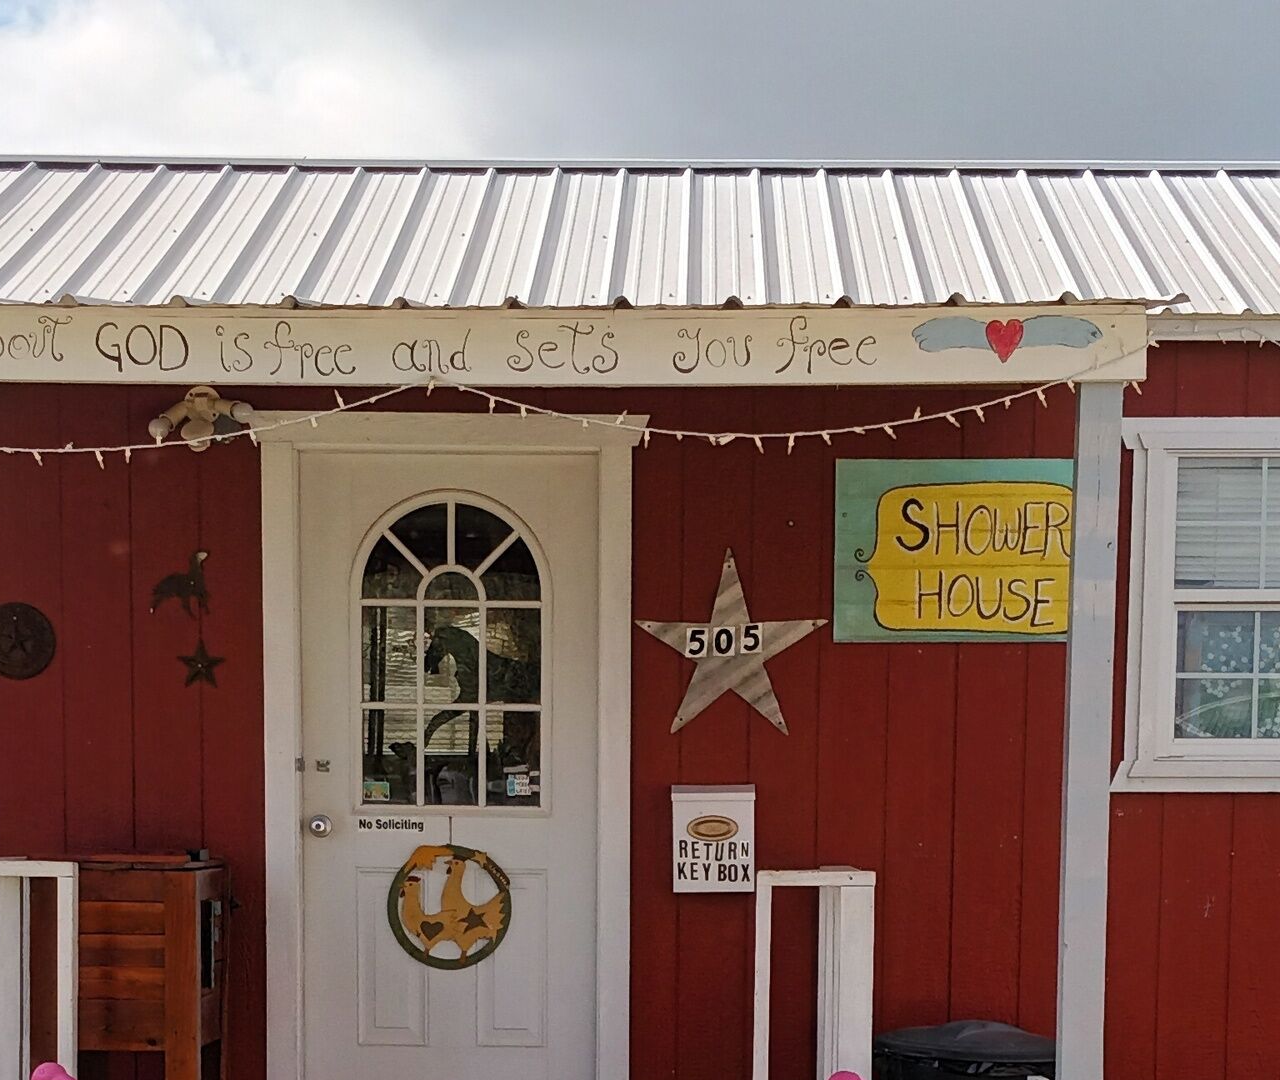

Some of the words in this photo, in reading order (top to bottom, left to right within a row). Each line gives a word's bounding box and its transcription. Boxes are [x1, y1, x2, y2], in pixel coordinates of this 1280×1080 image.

[96, 322, 189, 372] GOD
[216, 325, 253, 373] is
[264, 321, 357, 379] free
[392, 329, 472, 375] and
[775, 316, 877, 374] free
[895, 498, 1070, 557] SHOWER
[917, 570, 1055, 627] HOUSE
[688, 625, 760, 655] 505
[358, 819, 373, 830] No
[375, 819, 424, 832] Soliciting
[678, 839, 749, 861] RETURN
[677, 862, 711, 881] KEY
[717, 864, 751, 882] BOX
